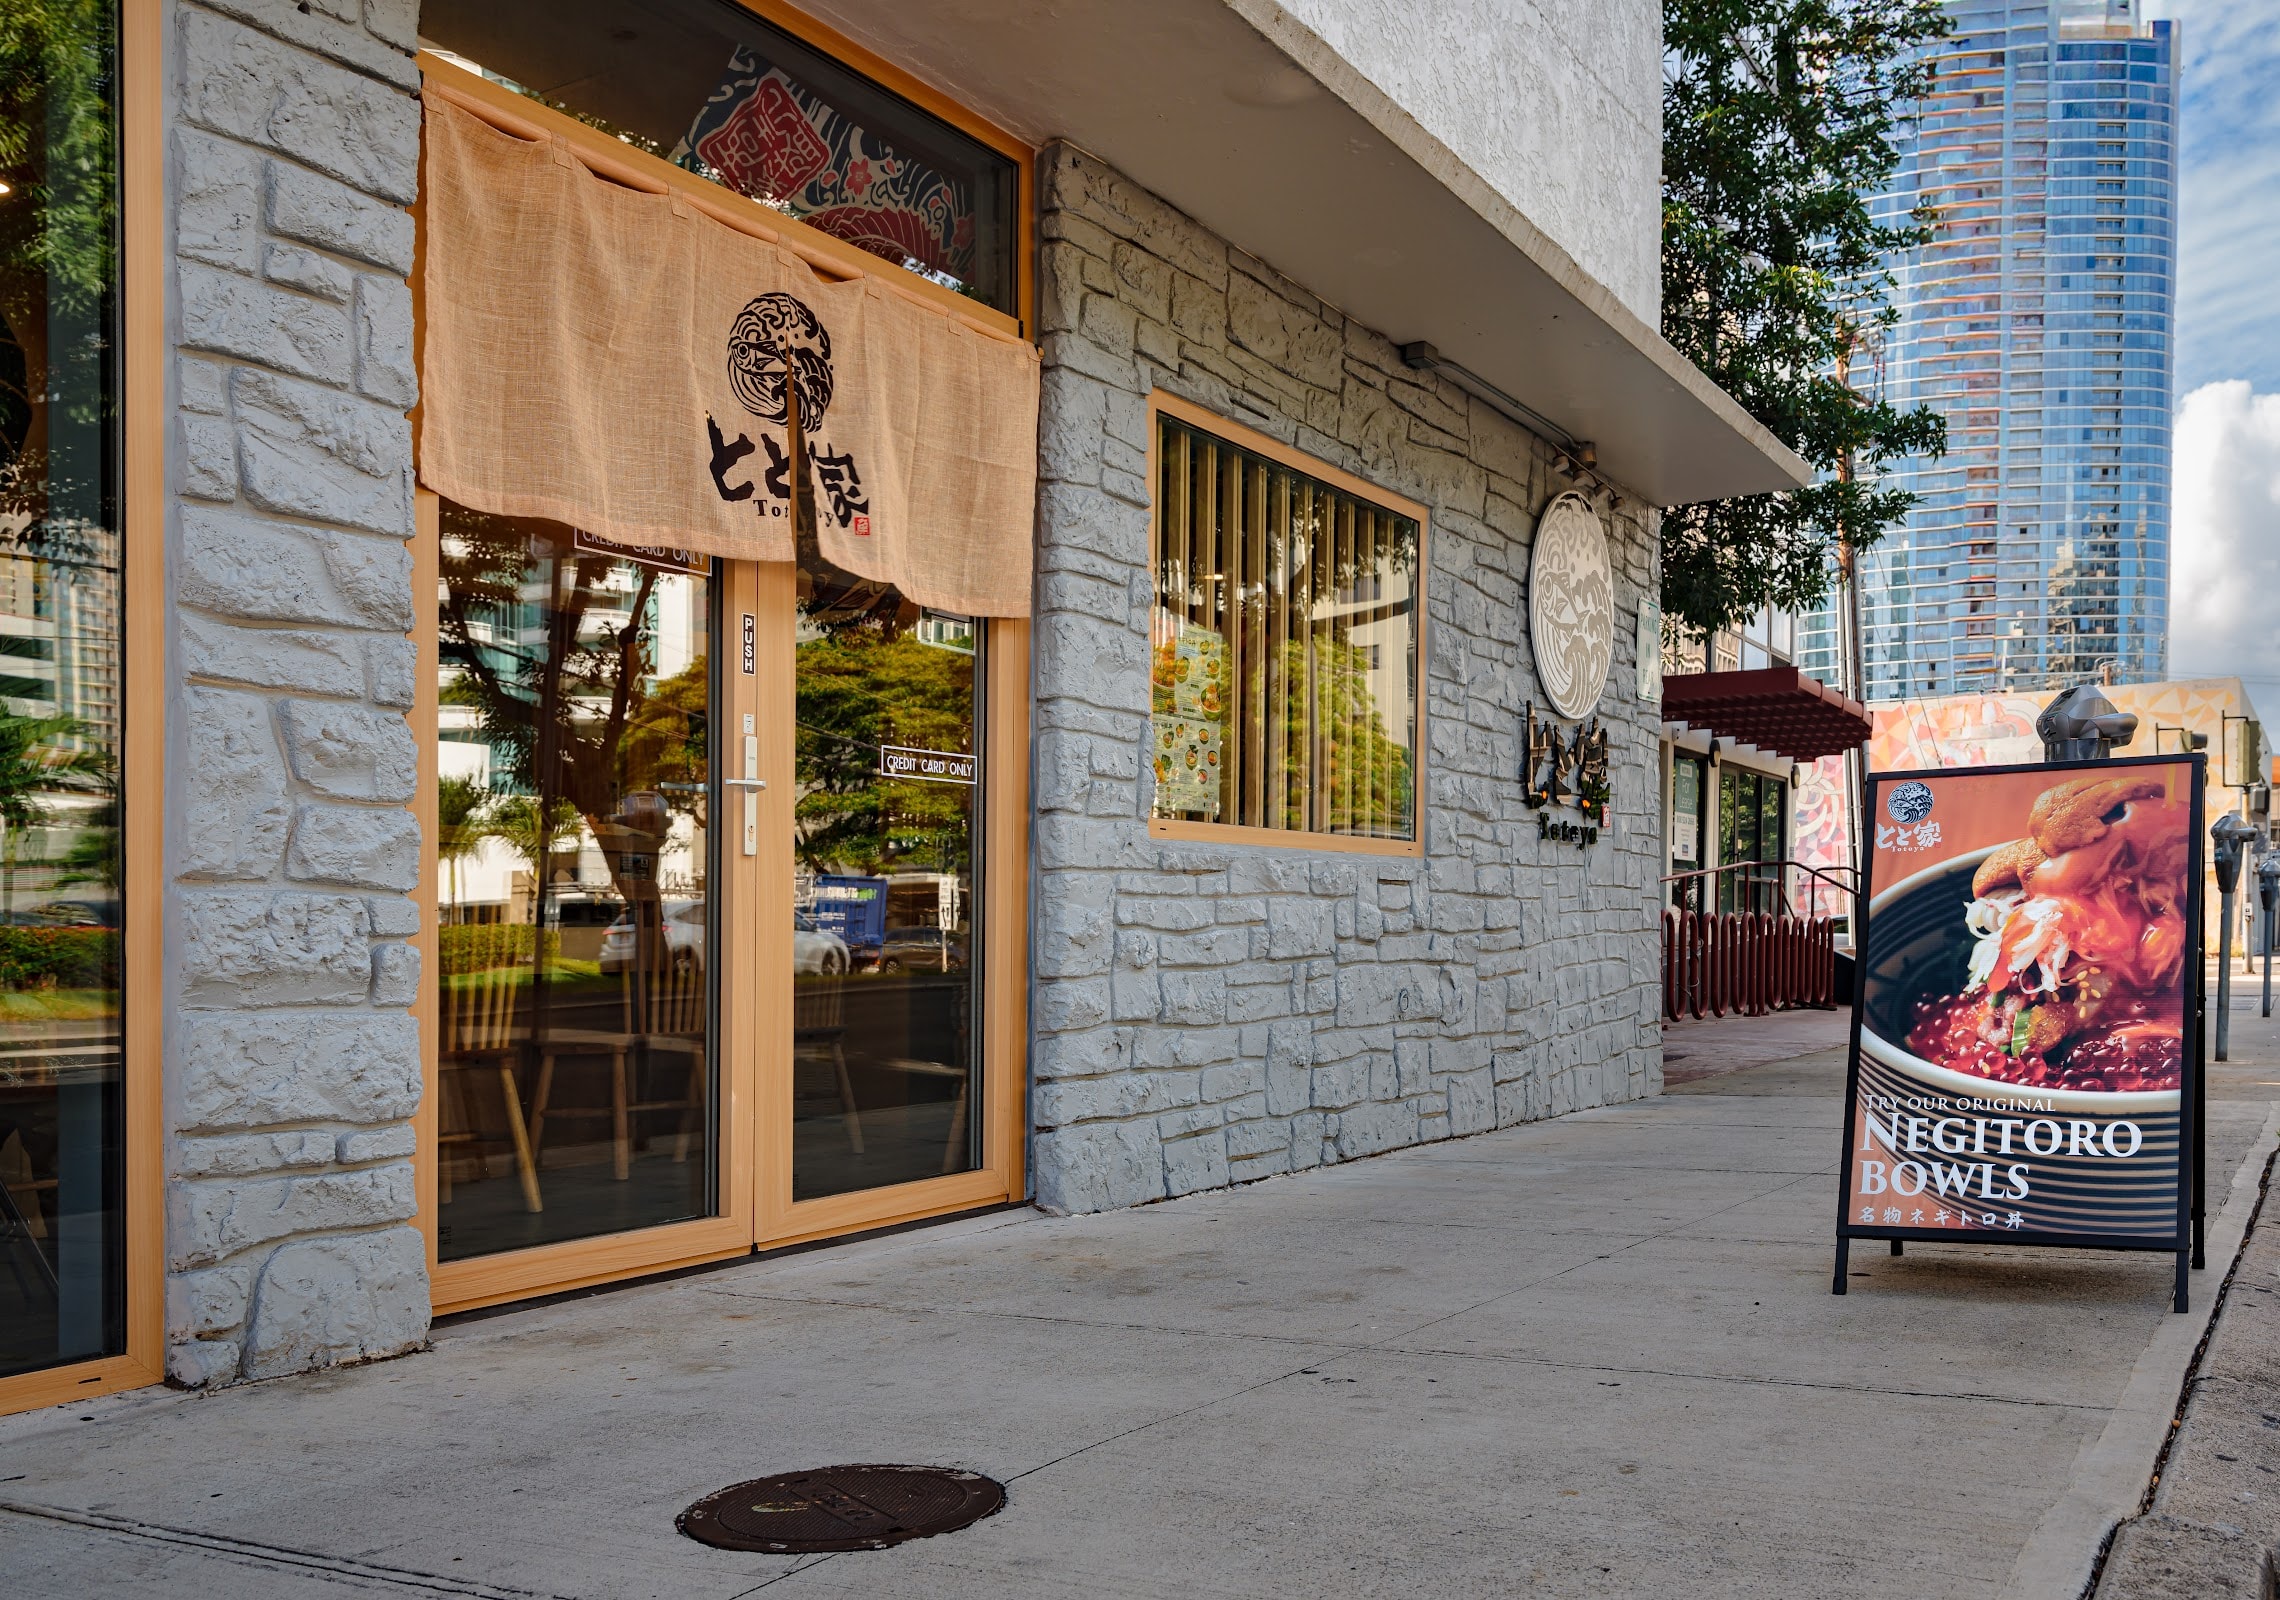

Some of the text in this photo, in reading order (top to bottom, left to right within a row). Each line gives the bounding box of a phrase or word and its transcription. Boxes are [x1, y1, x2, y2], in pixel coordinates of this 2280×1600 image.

[744, 617, 753, 672] PUSH
[886, 755, 973, 777] CREDIT CARD ONLY
[1875, 820, 1942, 849] とと家
[1890, 845, 1926, 853] Totoya
[1864, 1094, 2057, 1112] TRY OUR ORIGINAL
[1860, 1112, 2143, 1157] NEGITORO
[1857, 1159, 2030, 1200] BOWLS
[1858, 1206, 2025, 1230] 名物ネギトロ丼
